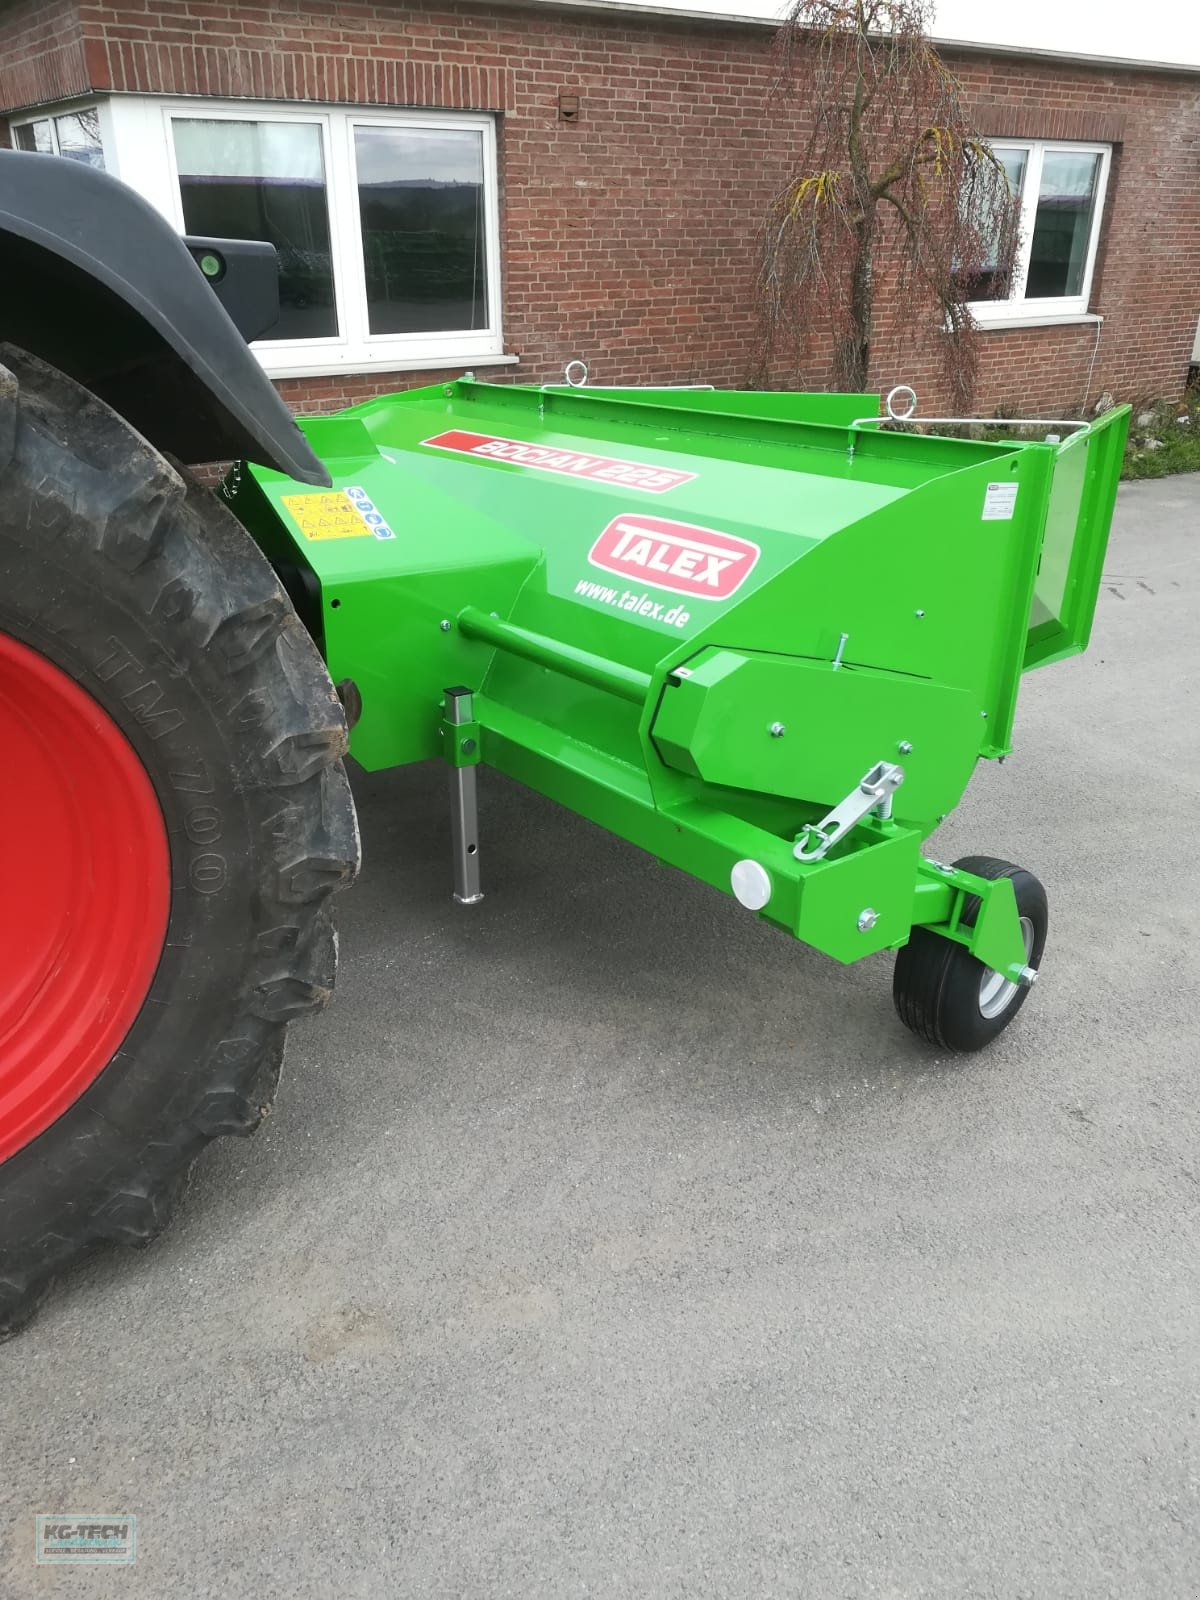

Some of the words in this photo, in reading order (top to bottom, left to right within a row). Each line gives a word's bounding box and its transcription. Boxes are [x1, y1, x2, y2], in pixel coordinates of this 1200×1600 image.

[471, 440, 597, 472] BOCIAN
[592, 464, 681, 487] 225
[610, 522, 747, 587] TALEX
[574, 579, 690, 628] www.talex.de
[96, 635, 186, 740] TM
[168, 752, 228, 894] 700
